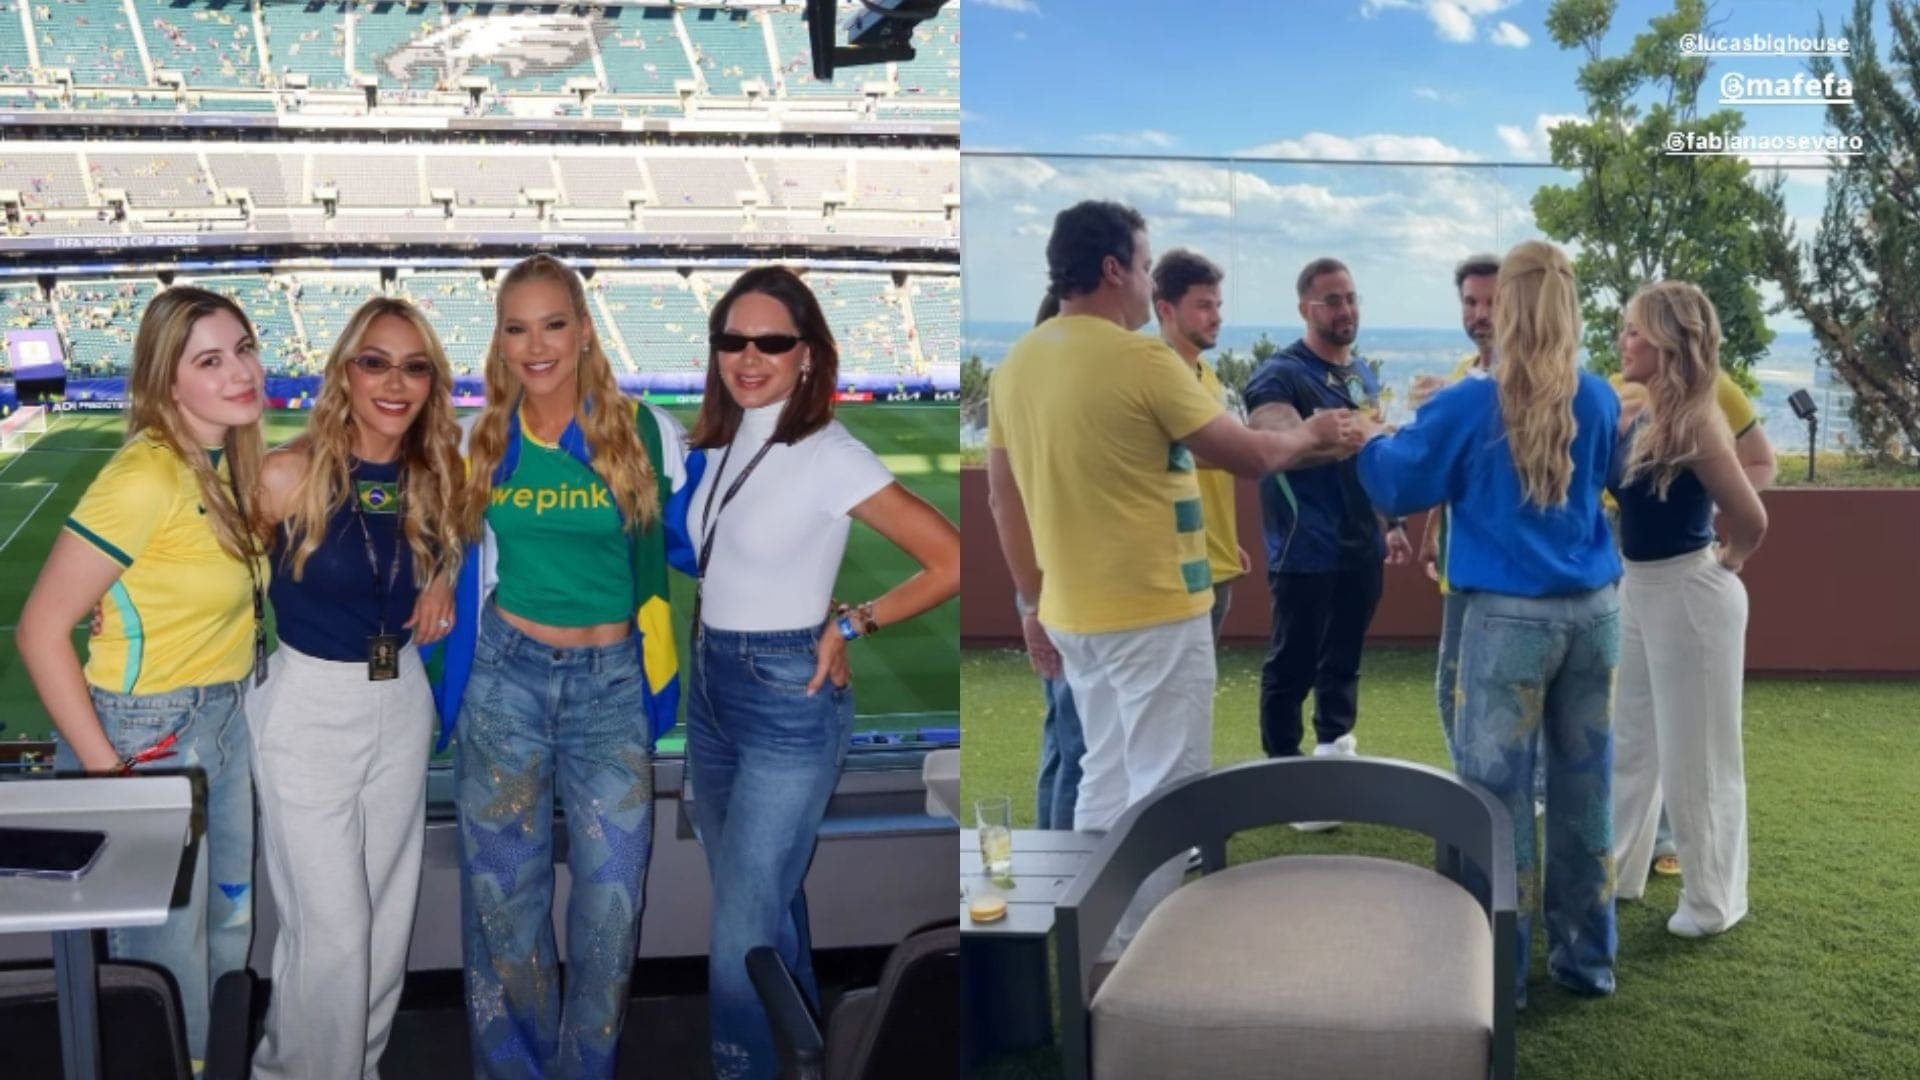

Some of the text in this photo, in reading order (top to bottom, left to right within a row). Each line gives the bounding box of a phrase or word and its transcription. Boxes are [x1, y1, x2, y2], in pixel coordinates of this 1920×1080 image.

[54, 237, 82, 248] FIFA
[83, 237, 129, 248] WORLD
[130, 236, 154, 247] CUP
[491, 482, 611, 516] wepink
